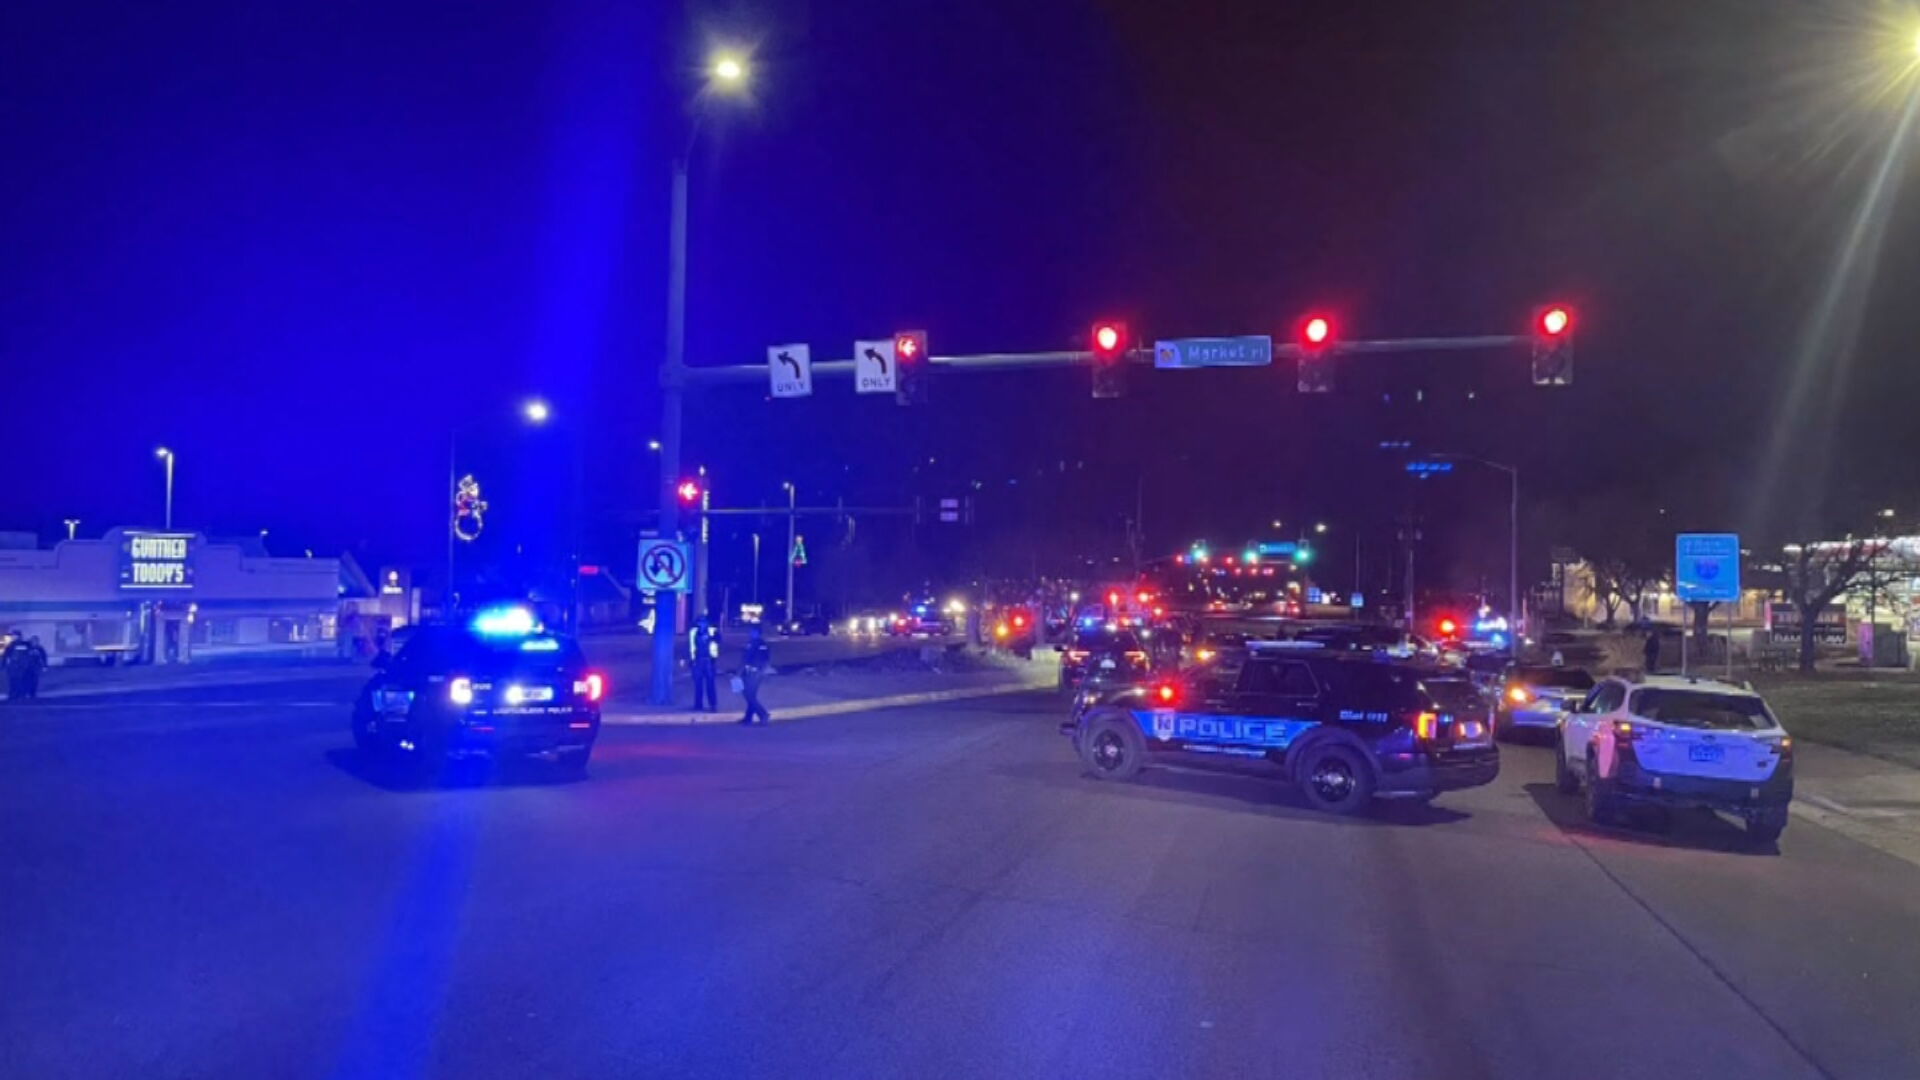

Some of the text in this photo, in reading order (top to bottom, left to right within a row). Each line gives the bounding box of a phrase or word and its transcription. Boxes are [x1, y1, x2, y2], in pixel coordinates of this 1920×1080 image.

[1188, 345, 1245, 362] Market
[776, 381, 806, 393] ONLY
[861, 376, 891, 389] ONLY
[1178, 718, 1287, 741] POLICE
